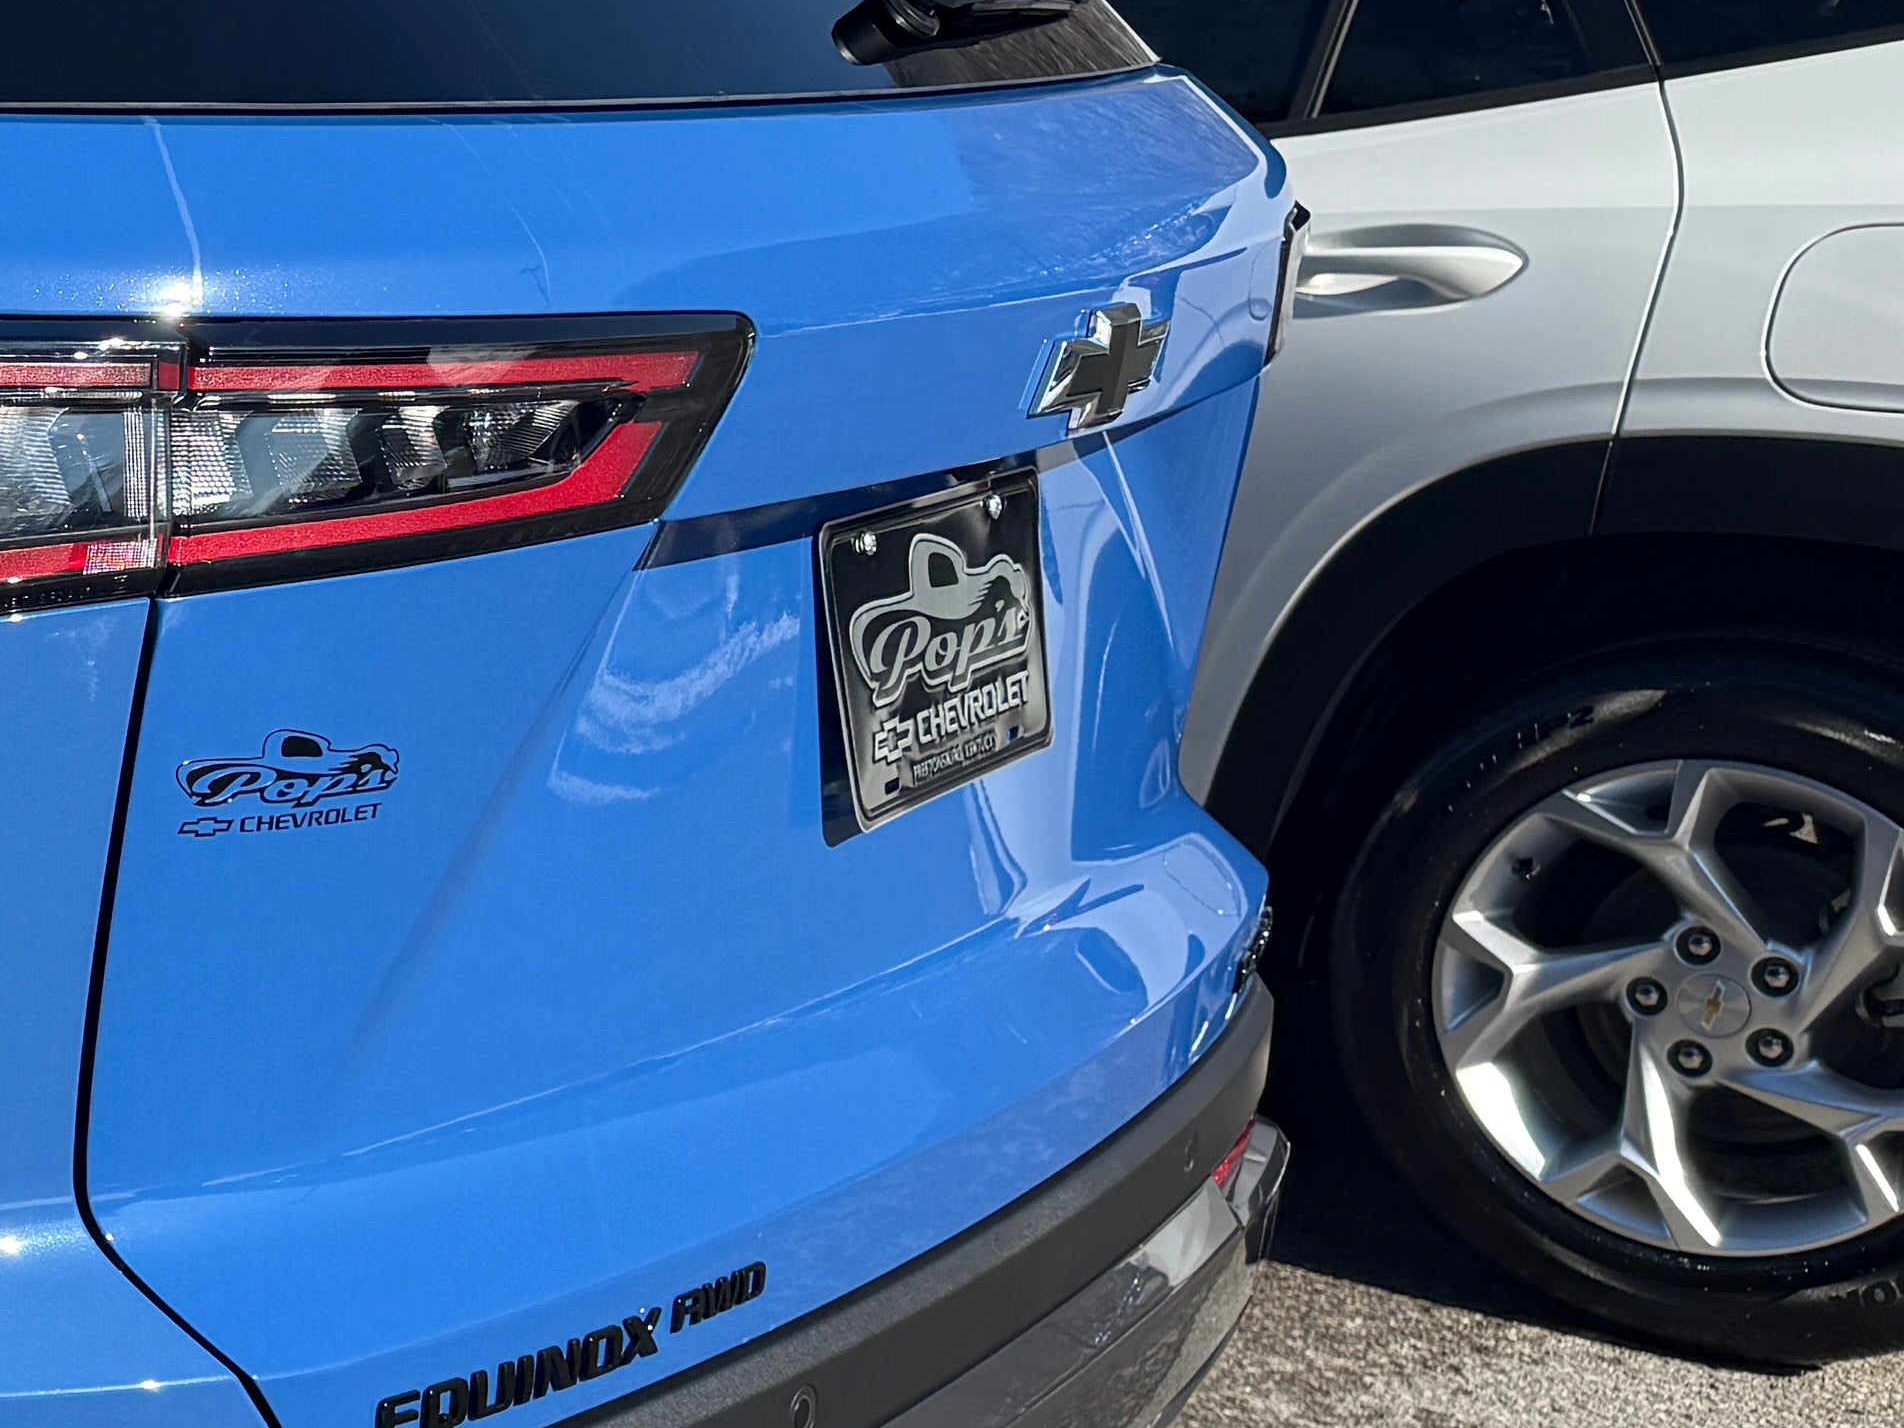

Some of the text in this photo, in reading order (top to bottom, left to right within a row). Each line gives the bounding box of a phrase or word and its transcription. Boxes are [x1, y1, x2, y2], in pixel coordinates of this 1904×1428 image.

[869, 598, 1026, 689] Pop's
[916, 669, 1030, 744] CHEVROLET
[191, 762, 395, 809] Pop's
[239, 802, 383, 833] CHEVROLET
[669, 1260, 768, 1335] AWD
